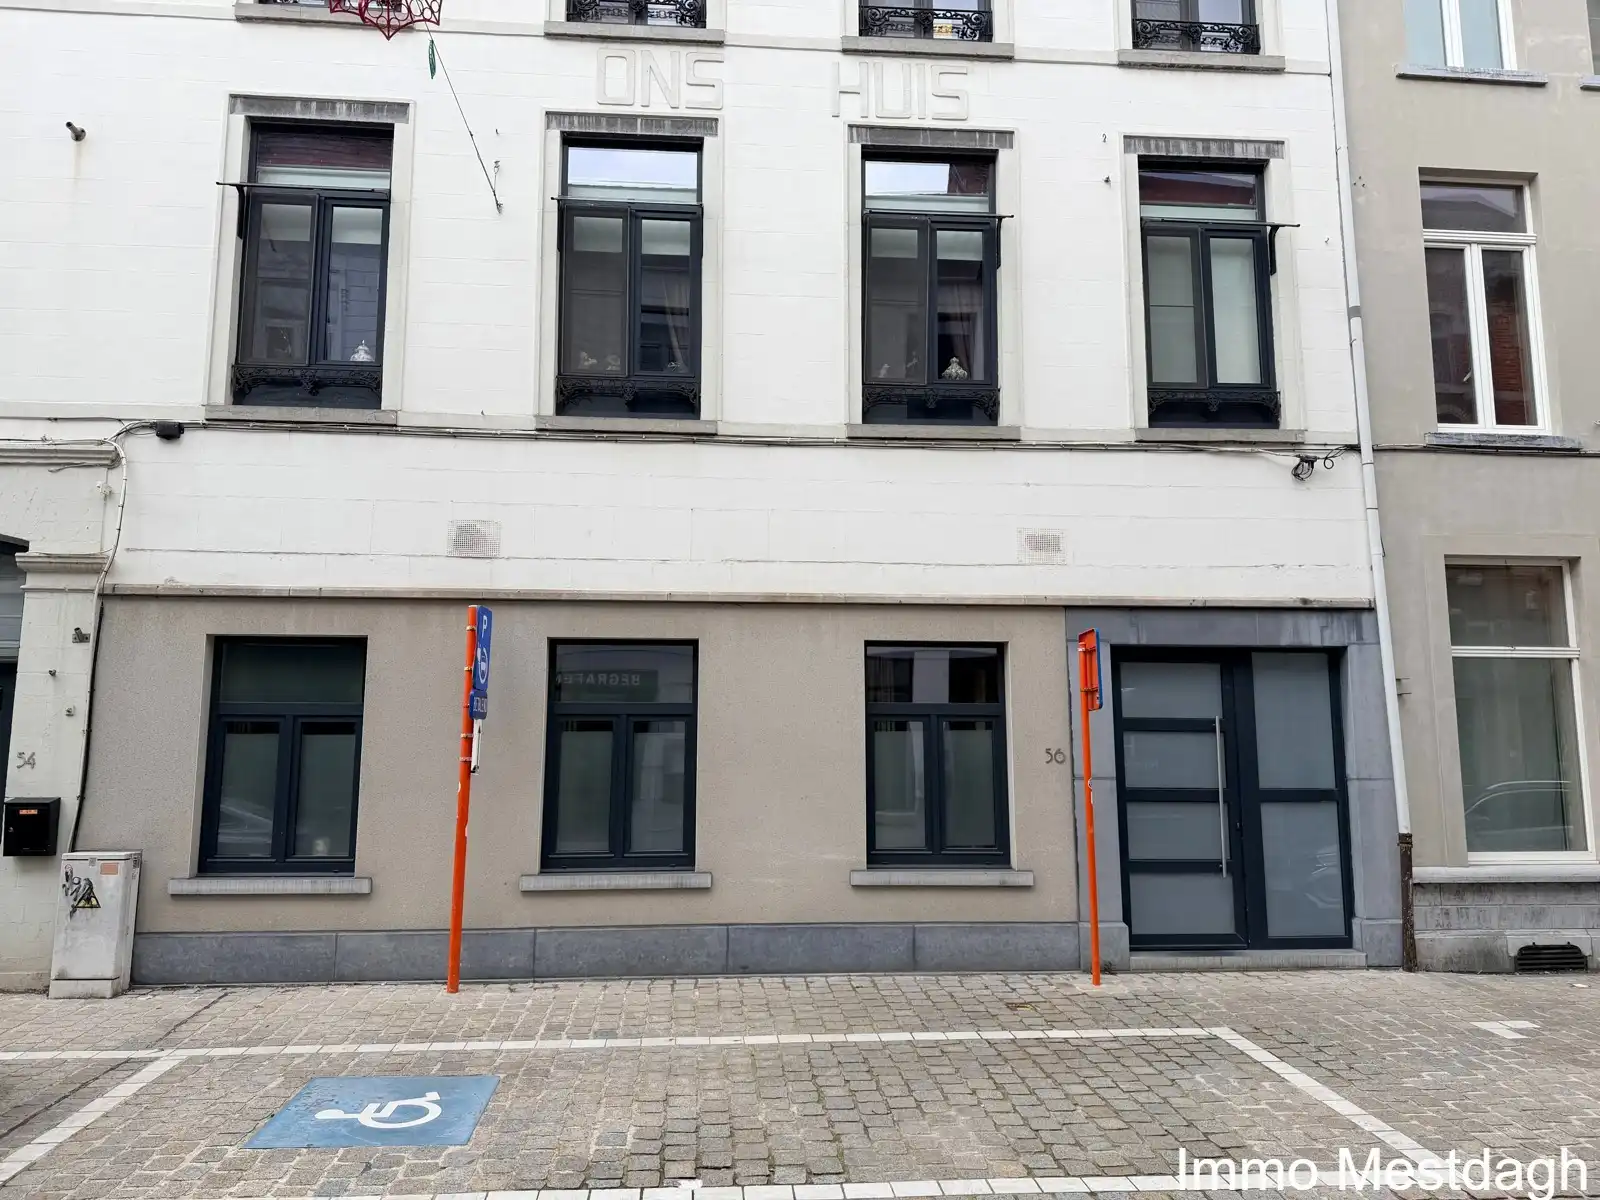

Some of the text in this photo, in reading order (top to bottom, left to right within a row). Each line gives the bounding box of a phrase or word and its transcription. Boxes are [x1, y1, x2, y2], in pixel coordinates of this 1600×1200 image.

[597, 48, 969, 121] ONS HUIS
[482, 614, 488, 638] P
[16, 751, 36, 769] 54
[1045, 747, 1066, 765] 56
